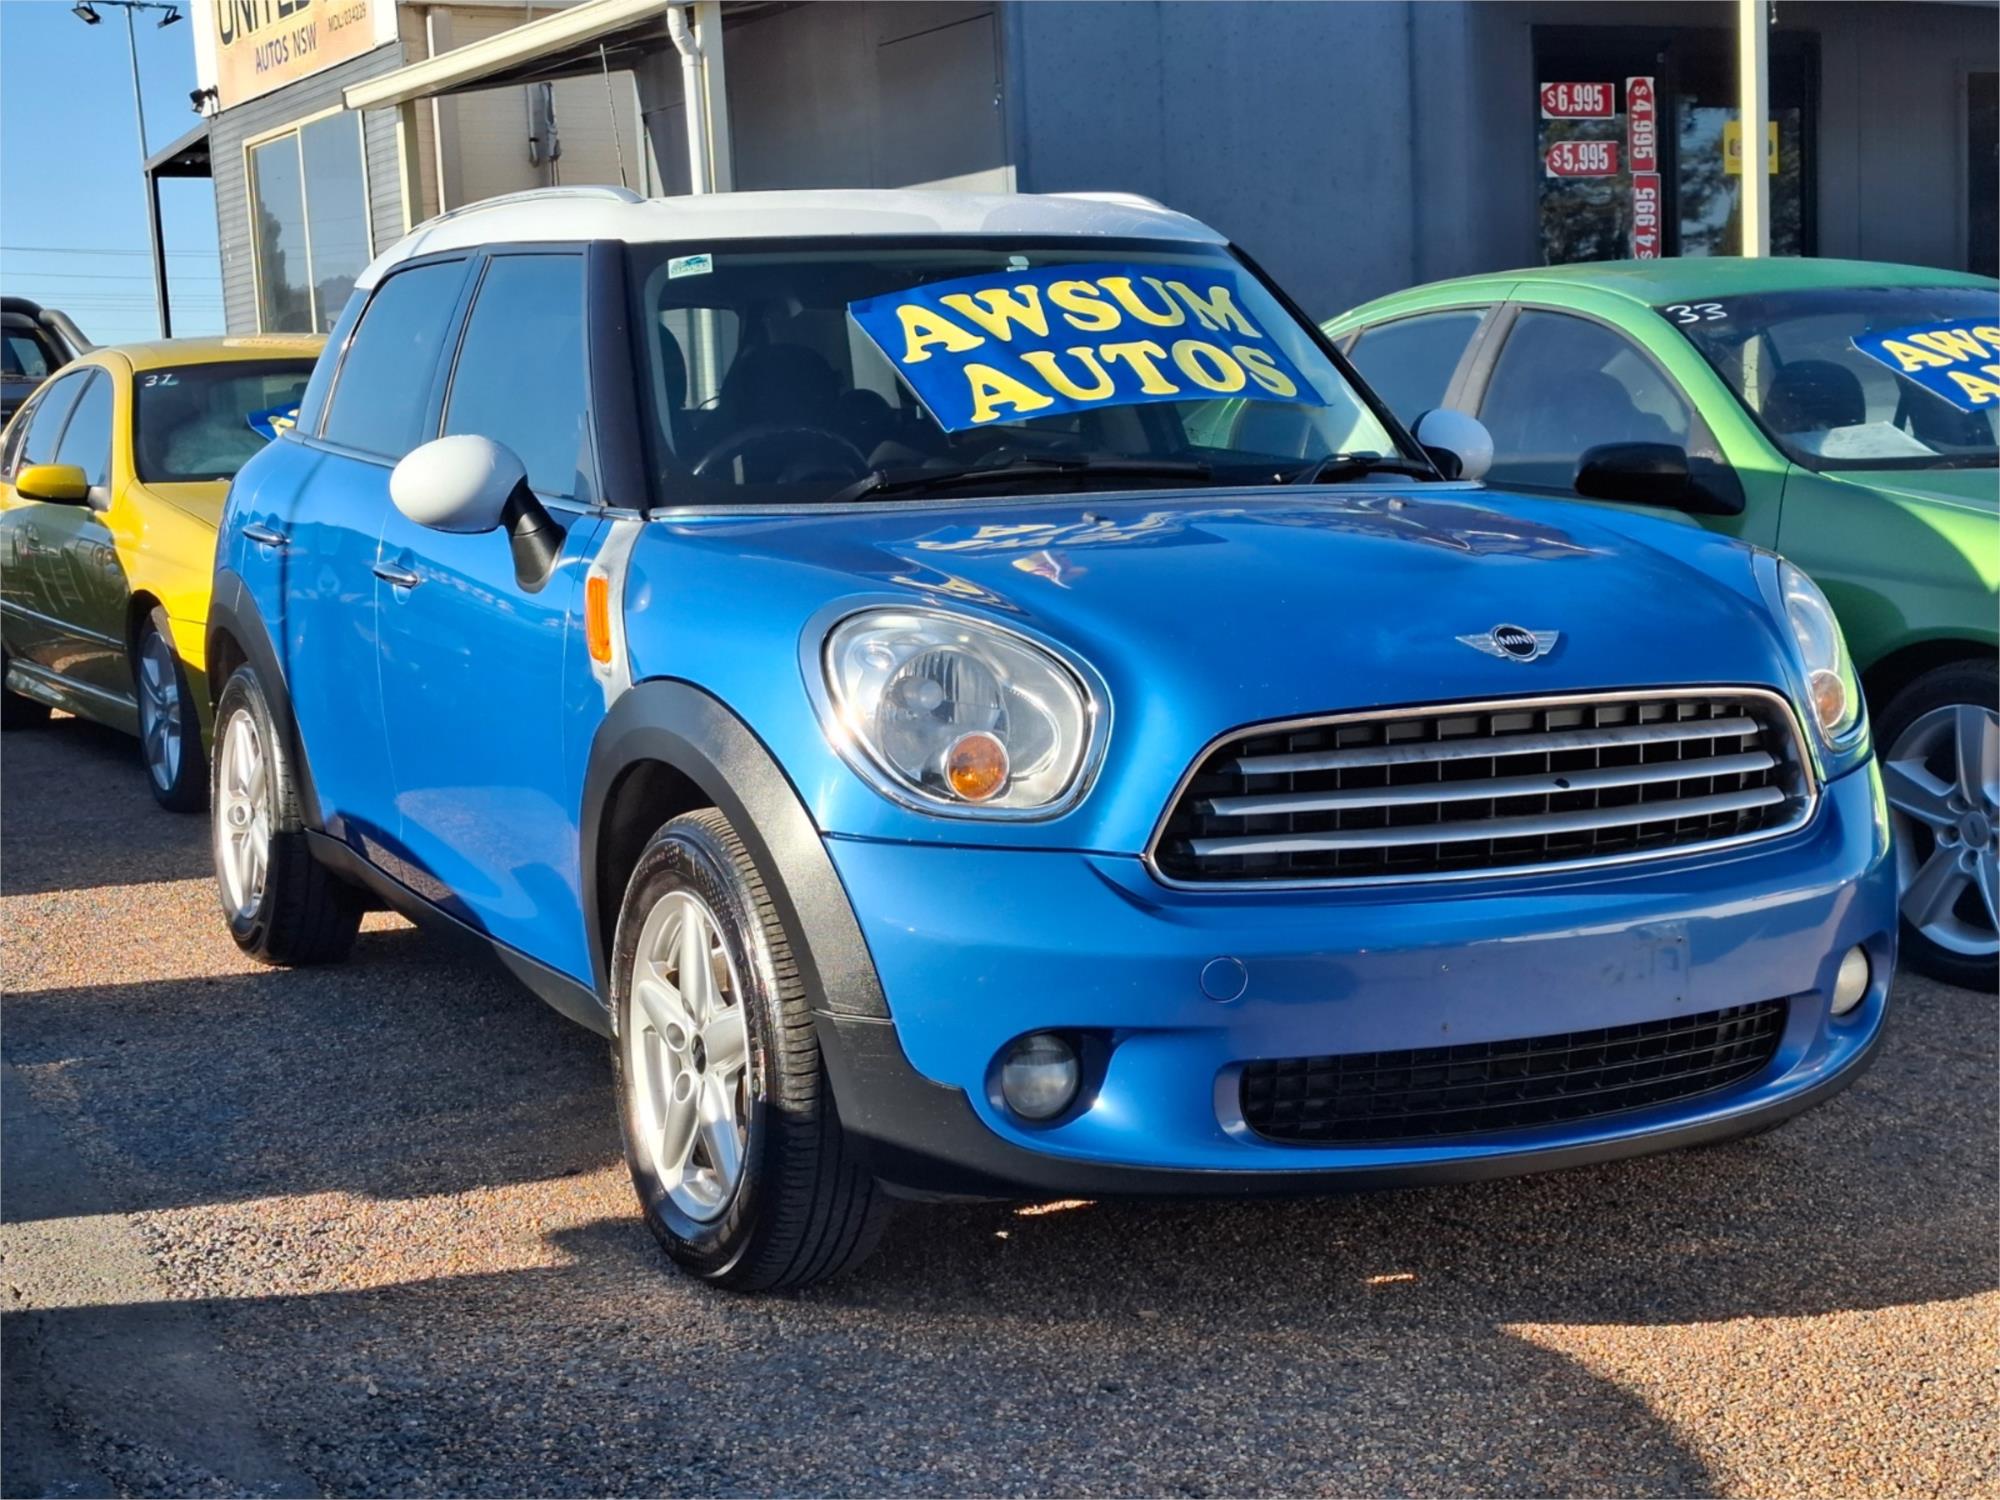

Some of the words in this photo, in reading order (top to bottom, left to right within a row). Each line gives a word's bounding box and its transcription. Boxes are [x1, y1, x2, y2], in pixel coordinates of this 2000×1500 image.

[256, 35, 289, 74] AUTOS
[292, 22, 317, 57] NSW
[1547, 85, 1604, 113] $6,995
[1632, 85, 1653, 159] $4,995
[1553, 144, 1609, 171] $5,995
[896, 276, 1261, 364] AWSUM
[1666, 303, 1728, 323] 33
[963, 339, 1296, 423] AUTOS
[1499, 634, 1536, 645] MINI
